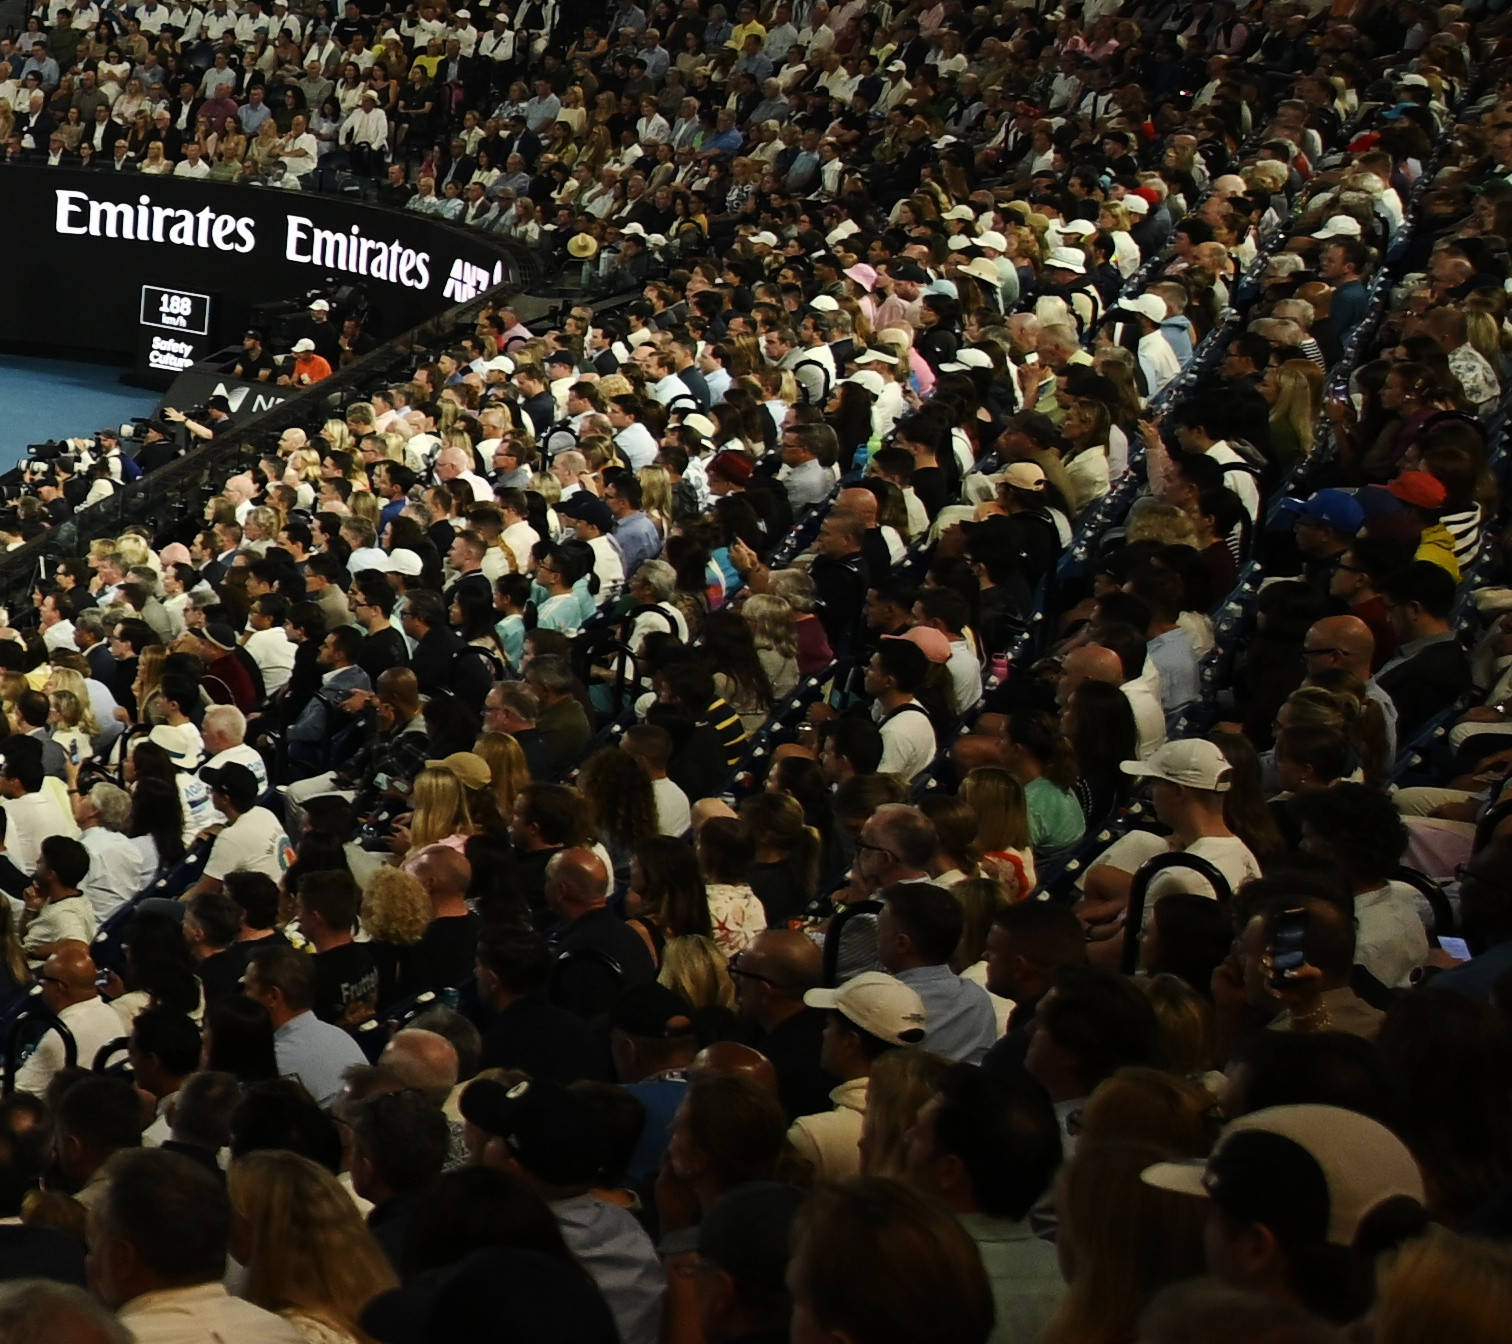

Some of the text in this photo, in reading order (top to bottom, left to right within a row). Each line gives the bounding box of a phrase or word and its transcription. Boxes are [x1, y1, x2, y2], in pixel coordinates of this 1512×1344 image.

[56, 189, 256, 253] Emirates
[286, 214, 430, 290] Emirates
[159, 293, 192, 316] 188
[152, 336, 194, 358] Safety
